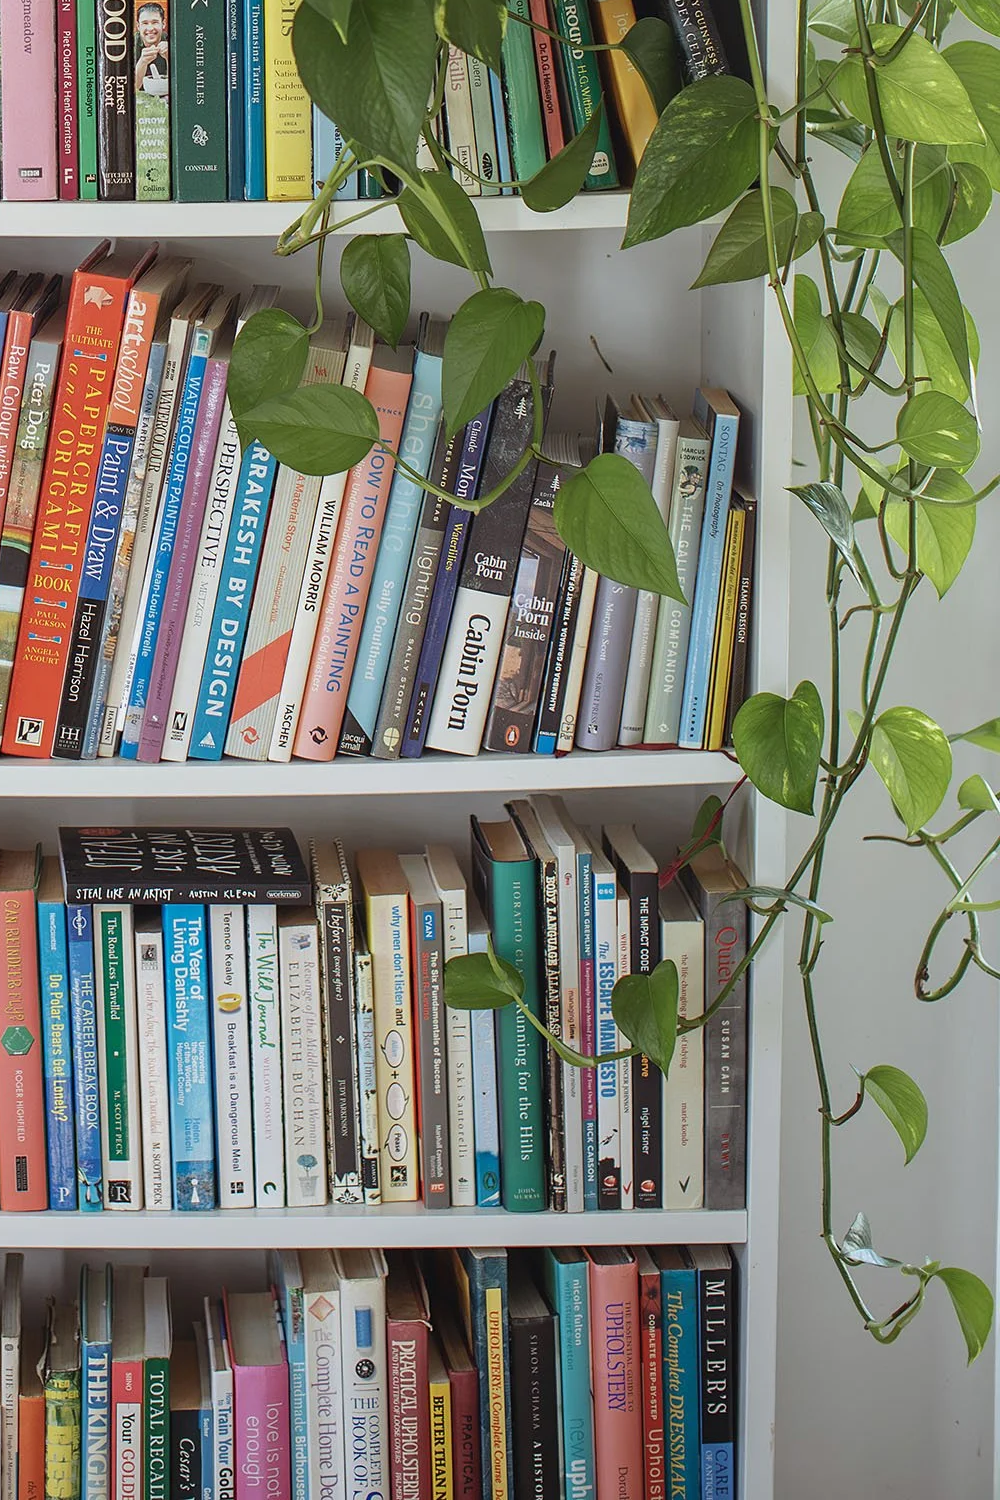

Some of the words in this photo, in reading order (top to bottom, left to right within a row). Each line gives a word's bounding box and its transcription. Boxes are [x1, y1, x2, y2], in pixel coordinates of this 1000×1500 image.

[474, 552, 507, 570] Cabin
[475, 565, 503, 581] Porn
[33, 577, 73, 593] BOOK
[515, 594, 554, 612] Cabin
[515, 609, 549, 626] Porn
[514, 626, 546, 642] Inside
[465, 613, 491, 676] Cabin
[448, 678, 478, 731] Porn
[76, 888, 102, 899] STEAL
[106, 888, 124, 899] LIKE
[128, 888, 141, 899] AN
[143, 888, 174, 901] ARTIST
[189, 889, 218, 898] AUSTIN
[223, 889, 256, 898] KLEON
[713, 925, 740, 986] Quiet
[706, 1279, 728, 1415] MILLER'S
[605, 1302, 627, 1413] UPHOLSTERY
